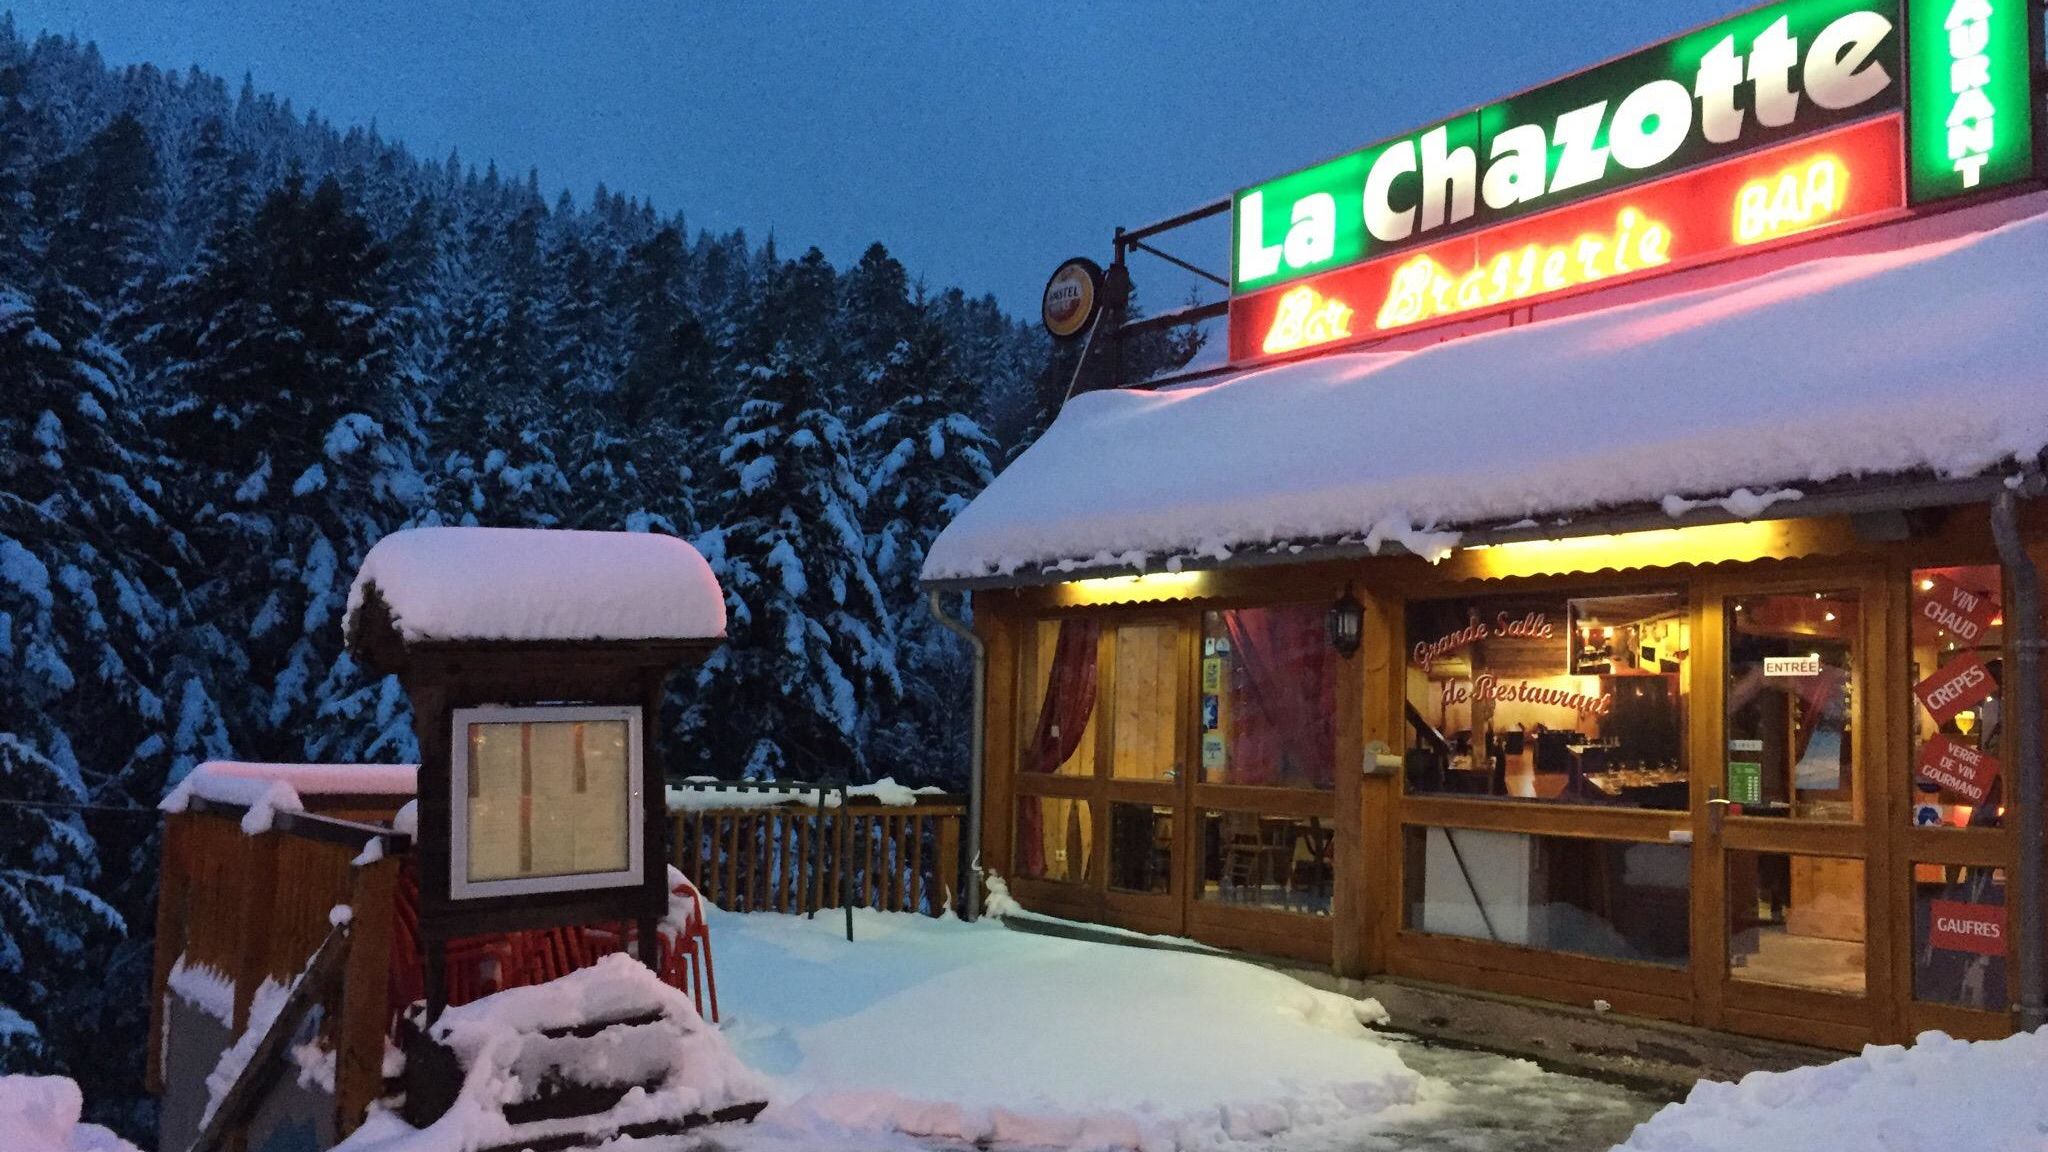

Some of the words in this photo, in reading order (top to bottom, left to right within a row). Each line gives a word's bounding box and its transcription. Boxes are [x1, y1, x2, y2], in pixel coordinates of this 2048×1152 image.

[1238, 190, 1336, 283] La
[1362, 10, 1893, 242] Chazotte
[1263, 286, 1353, 354] Bar
[1376, 206, 1671, 330] Brasserie
[1951, 586, 1979, 613] VIN
[1924, 601, 1978, 640] CHAUD
[1413, 617, 1489, 672] Grande
[1494, 610, 1554, 640] Salle
[1766, 659, 1818, 673] ENTRÉE
[1441, 677, 1467, 706] de
[1468, 674, 1610, 716] Restaurant
[1939, 756, 1955, 771] DE
[1958, 763, 1977, 781] VIN
[1948, 742, 1982, 767] VERRE
[1922, 765, 1982, 801] GOURMAND
[1937, 917, 2001, 938] GAUFRES
